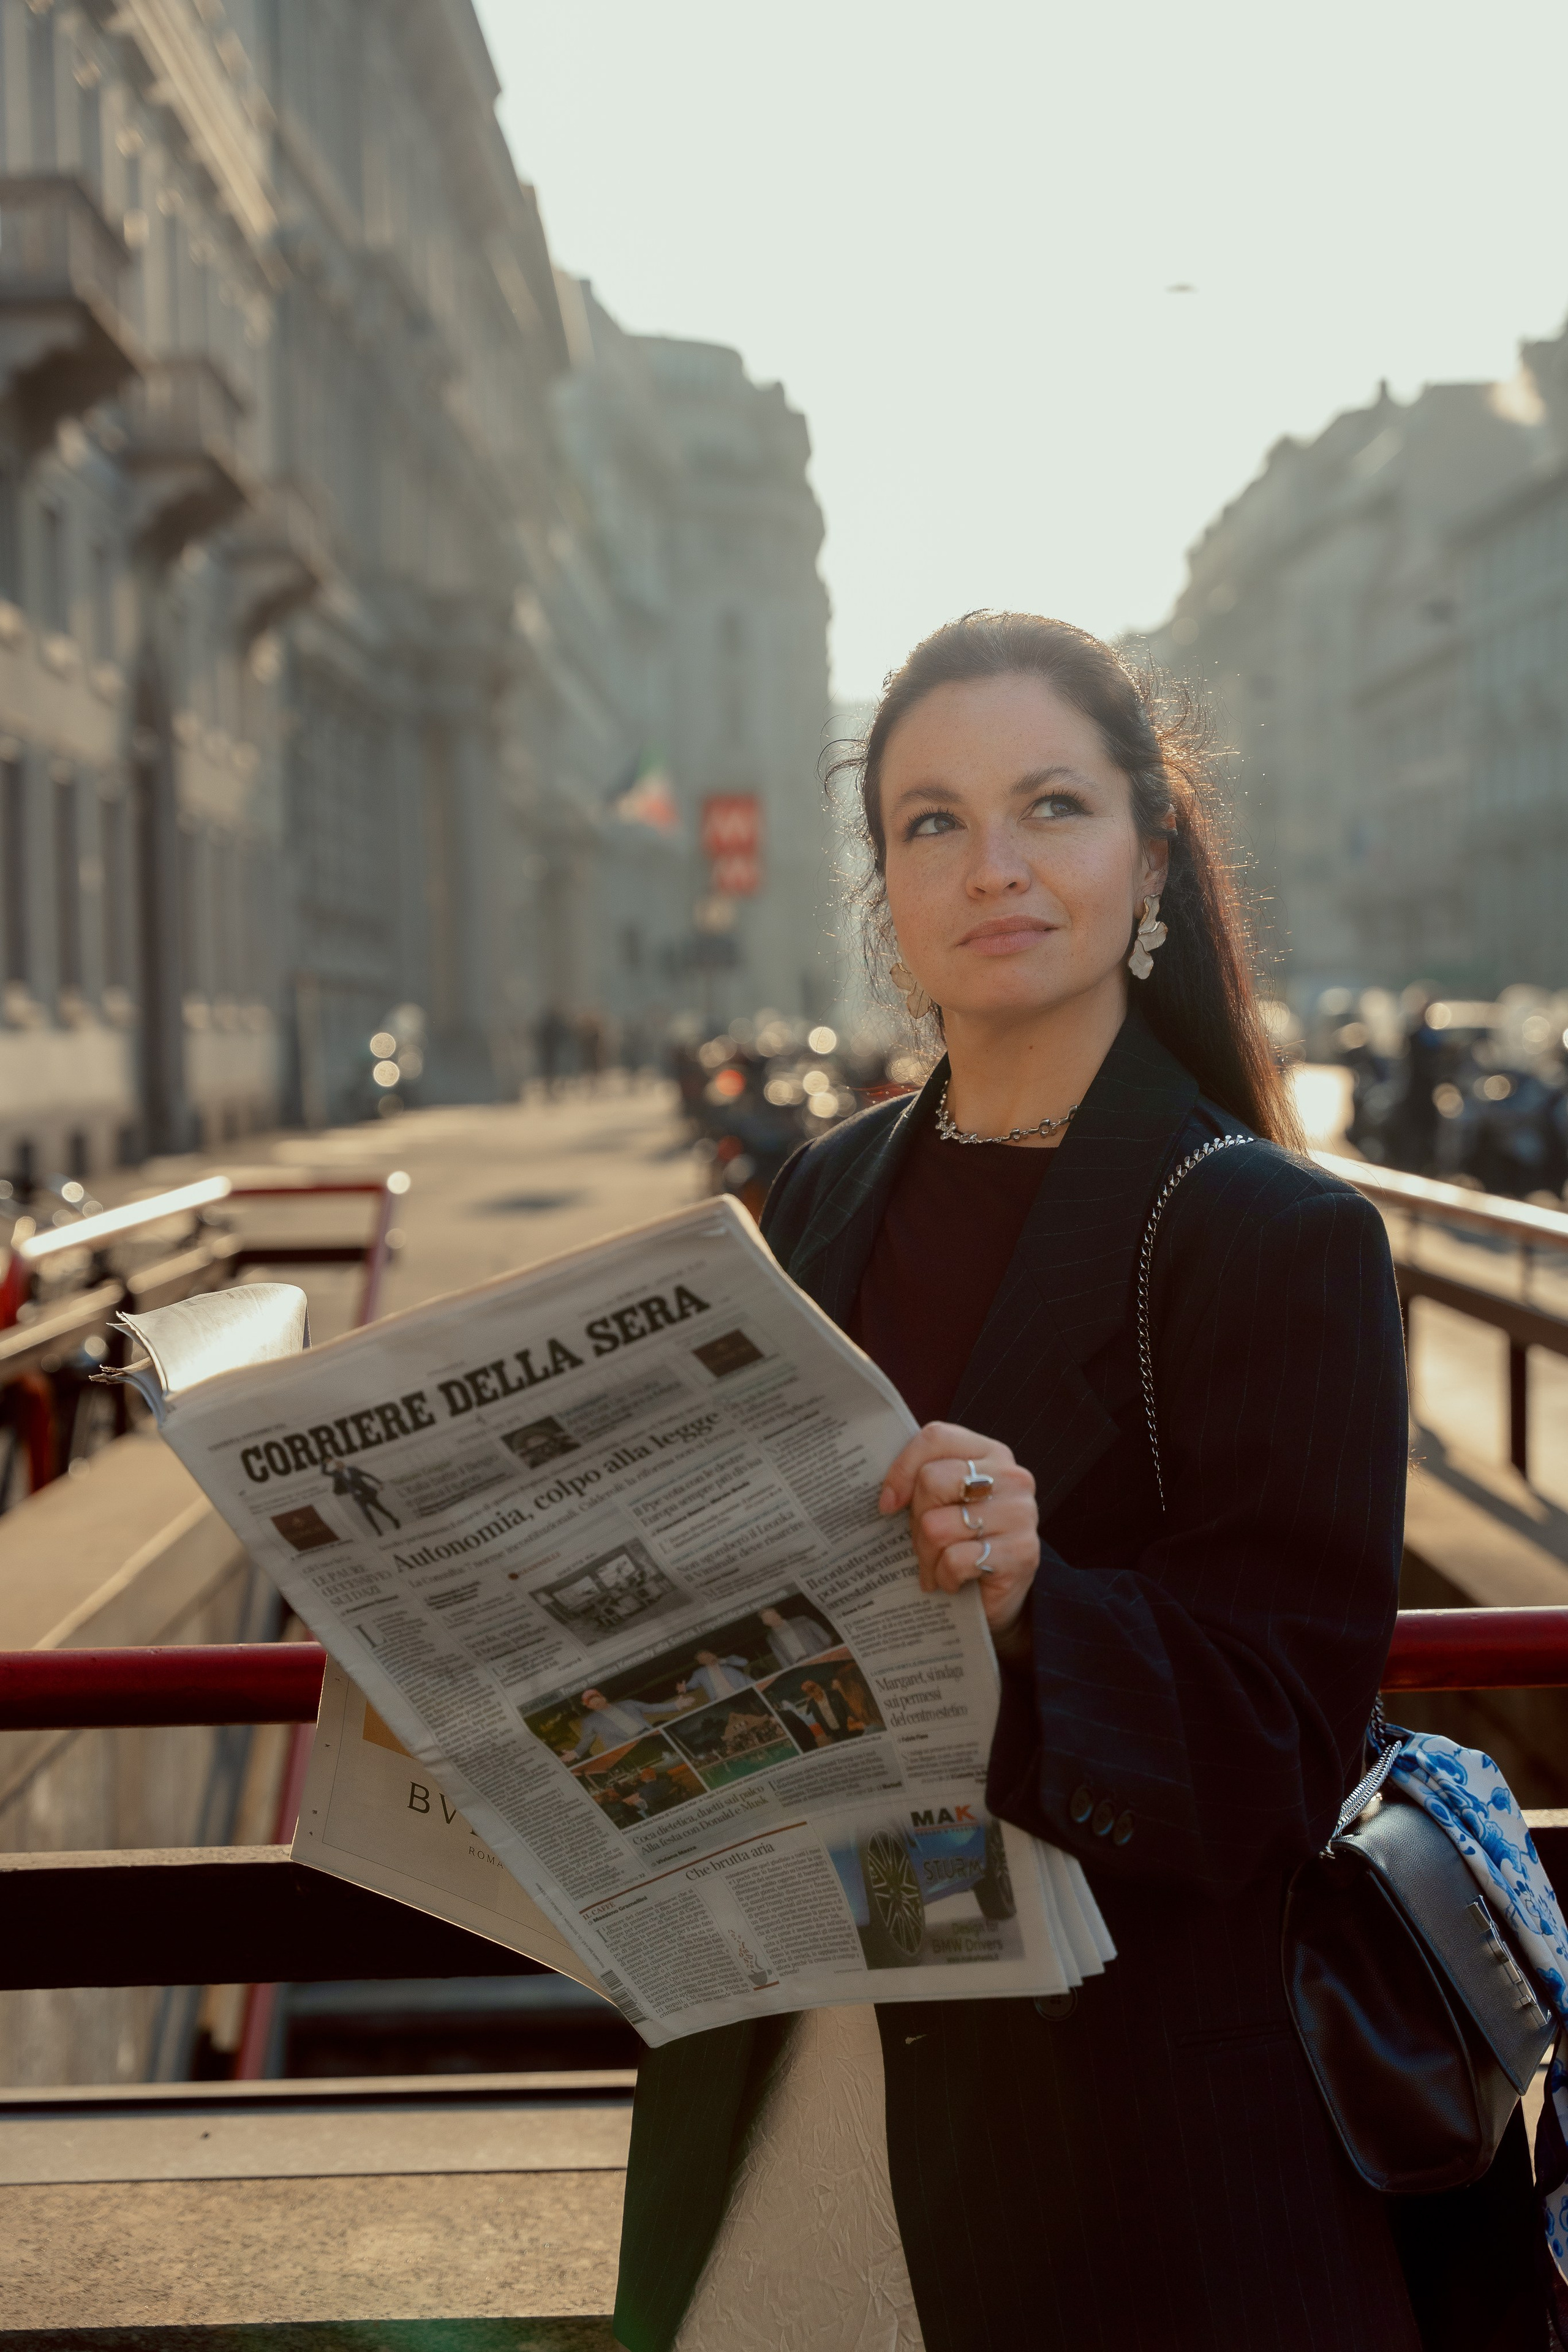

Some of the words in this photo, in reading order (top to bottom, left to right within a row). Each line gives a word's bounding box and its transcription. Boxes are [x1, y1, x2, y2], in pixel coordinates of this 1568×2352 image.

[240, 1392, 435, 1482] CORRIERE
[437, 1338, 584, 1417] DELLA
[586, 1284, 710, 1358] SERA
[393, 1509, 533, 1574] Autonomia,
[534, 1468, 601, 1510] colpo
[603, 1442, 652, 1474] alla
[649, 1412, 720, 1450] legge
[641, 1504, 679, 1528] Europa
[677, 1484, 716, 1508] sempre
[715, 1472, 734, 1489] più
[732, 1458, 763, 1477] divisa
[642, 1498, 662, 1514] Ppe
[662, 1487, 684, 1503] vota
[683, 1474, 706, 1489] con
[715, 1452, 745, 1472] destre
[472, 1550, 505, 1568] norme
[636, 1458, 674, 1482] riforma
[674, 1449, 695, 1461] non
[693, 1555, 736, 1580] Viminale
[737, 1541, 764, 1558] deve
[763, 1520, 806, 1547] risarcire
[701, 1532, 751, 1566] sgomberò
[755, 1510, 796, 1535] Leonka
[311, 1574, 326, 1589] LE
[325, 1563, 368, 1583] PAURE
[820, 1553, 867, 1586] contatto
[864, 1544, 888, 1562] sui
[816, 1585, 840, 1605] poi
[838, 1578, 852, 1591] la
[827, 1580, 876, 1611] arrestati
[874, 1569, 901, 1590] due
[558, 1678, 589, 1697] Trump
[588, 1666, 617, 1686] nomina
[616, 1649, 655, 1672] Kennedy
[655, 1642, 669, 1655] alla
[702, 1605, 753, 1632] repubblicani
[876, 1669, 927, 1693] Margaret,
[936, 1664, 964, 1683] indaga
[883, 1695, 901, 1711] sui
[899, 1687, 943, 1711] permessi
[890, 1711, 910, 1728] del
[908, 1708, 938, 1726] centro
[937, 1703, 968, 1721] estetico
[407, 1781, 480, 1837] BV
[633, 1831, 657, 1846] Coca
[657, 1815, 695, 1838] dietetica,
[696, 1800, 726, 1819] duetti
[724, 1793, 739, 1809] sul
[739, 1784, 765, 1804] palco
[910, 1804, 976, 1828] MAK
[641, 1841, 662, 1857] Alla
[660, 1832, 684, 1849] festa
[683, 1826, 701, 1838] con
[699, 1810, 737, 1831] Donald
[739, 1794, 770, 1814] Musk
[467, 1845, 505, 1869] ROMA
[655, 1852, 679, 1867] Viviana
[677, 1845, 698, 1858] Mazza
[685, 1863, 712, 1882] Che
[710, 1852, 751, 1873] brutta
[750, 1841, 775, 1858] aria
[922, 1856, 984, 1883] STURM
[592, 1908, 619, 1923] Massimo
[617, 1895, 648, 1911] Gramellini
[605, 1937, 623, 1948] locale.
[663, 1913, 678, 1921] Selva
[685, 1902, 704, 1913] Cadore
[616, 1947, 643, 1962] sponsabili
[619, 1936, 640, 1948] cancella
[932, 1938, 961, 1953] BMW
[964, 1936, 1003, 1953] Drivers
[641, 1970, 660, 1981] sociali
[669, 1958, 692, 1969] comitati
[691, 1950, 725, 1961] studenteschi,
[658, 2005, 683, 2018] criminale
[664, 1999, 685, 2009] popoli.
[697, 1988, 723, 1997] considera
